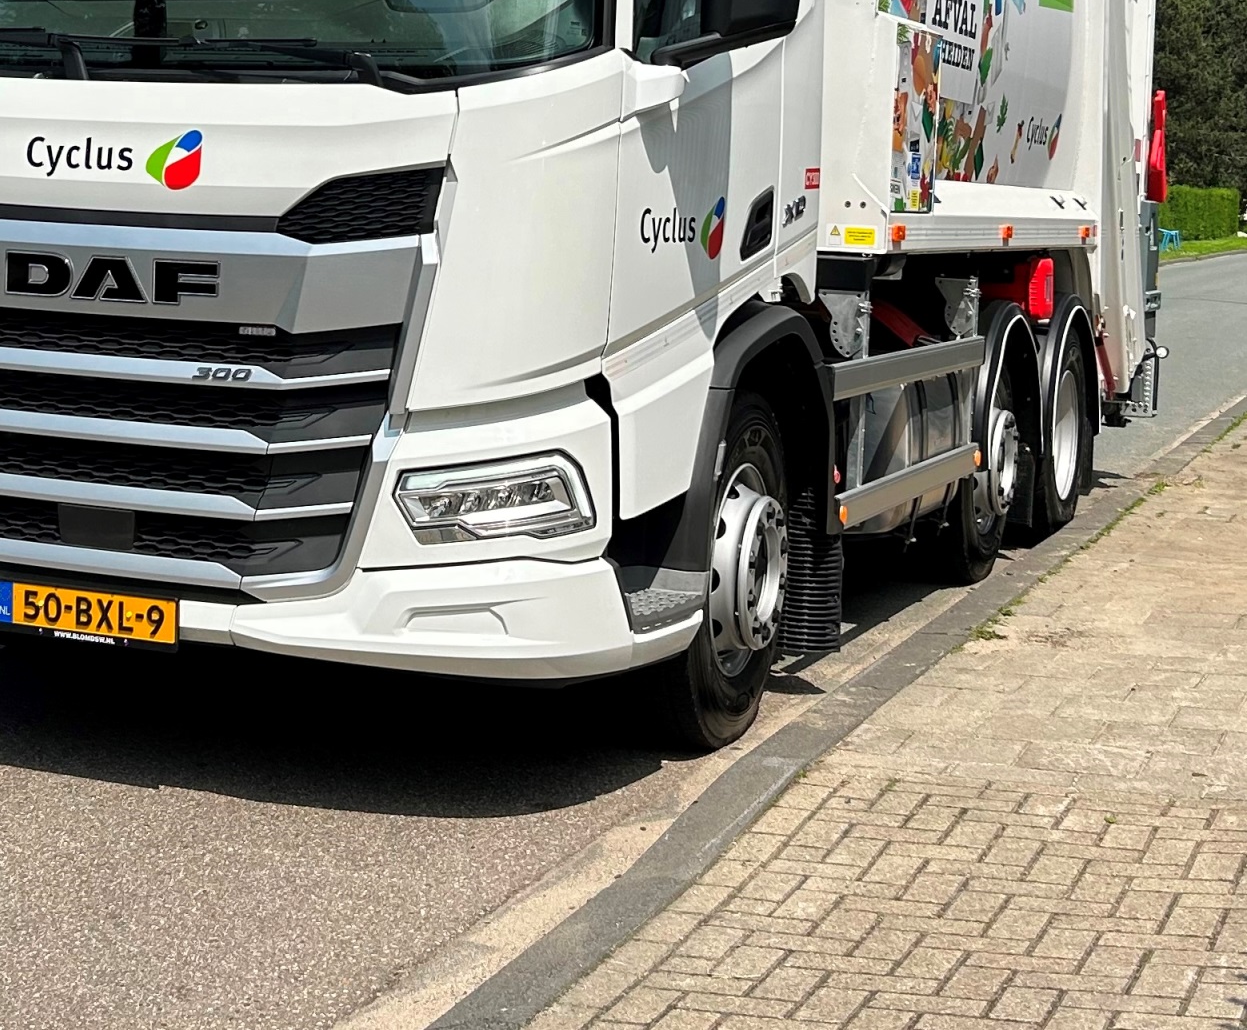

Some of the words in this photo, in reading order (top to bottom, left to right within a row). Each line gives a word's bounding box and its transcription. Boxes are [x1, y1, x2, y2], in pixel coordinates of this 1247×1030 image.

[1026, 116, 1049, 151] Cyclus
[26, 136, 134, 177] Cyclus
[640, 207, 696, 254] Cyclus
[4, 250, 221, 305] DAF
[192, 366, 253, 383] 300
[0, 605, 11, 616] NL
[24, 589, 165, 638] 50-BXL-9
